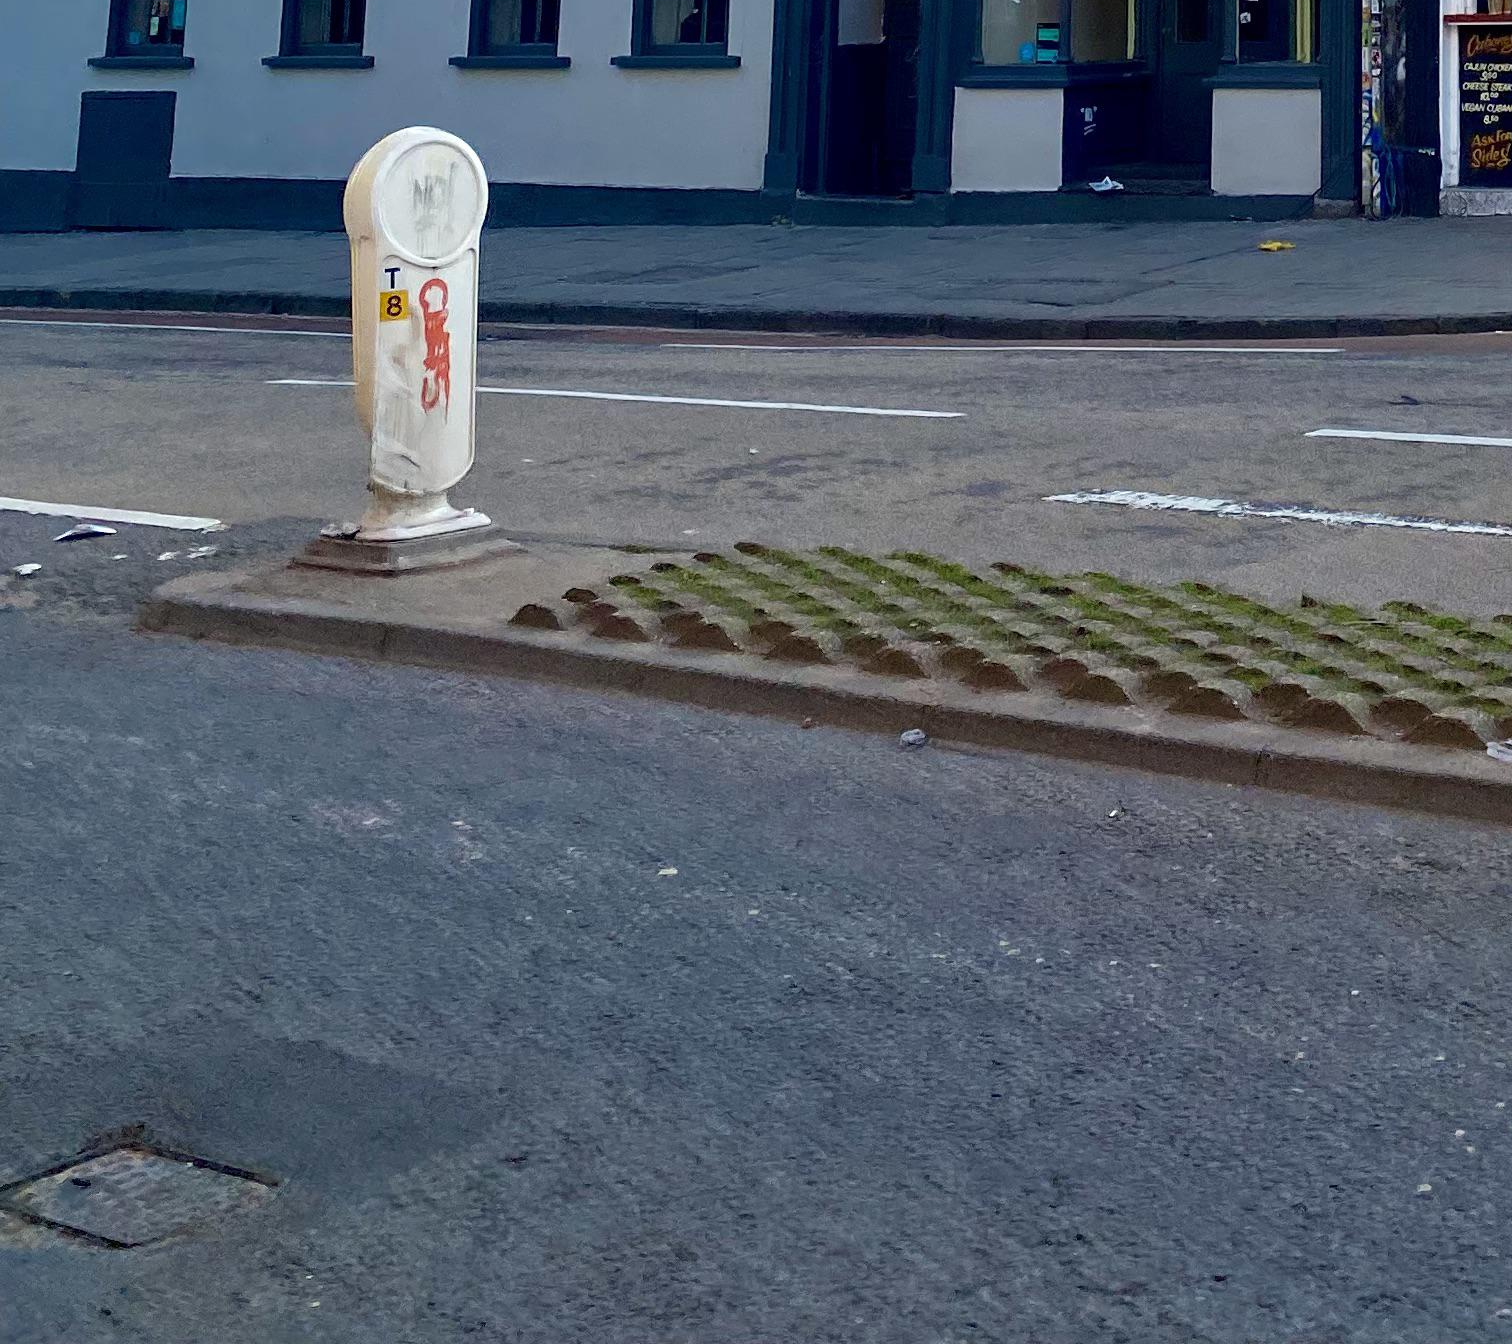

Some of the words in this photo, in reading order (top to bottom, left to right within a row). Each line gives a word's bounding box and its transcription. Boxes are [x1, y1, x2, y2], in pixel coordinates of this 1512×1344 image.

[1463, 82, 1489, 91] CHEESE
[1490, 83, 1512, 91] STEAK
[1461, 102, 1485, 112] VEGAN
[384, 267, 401, 289] T
[386, 294, 403, 317] 8
